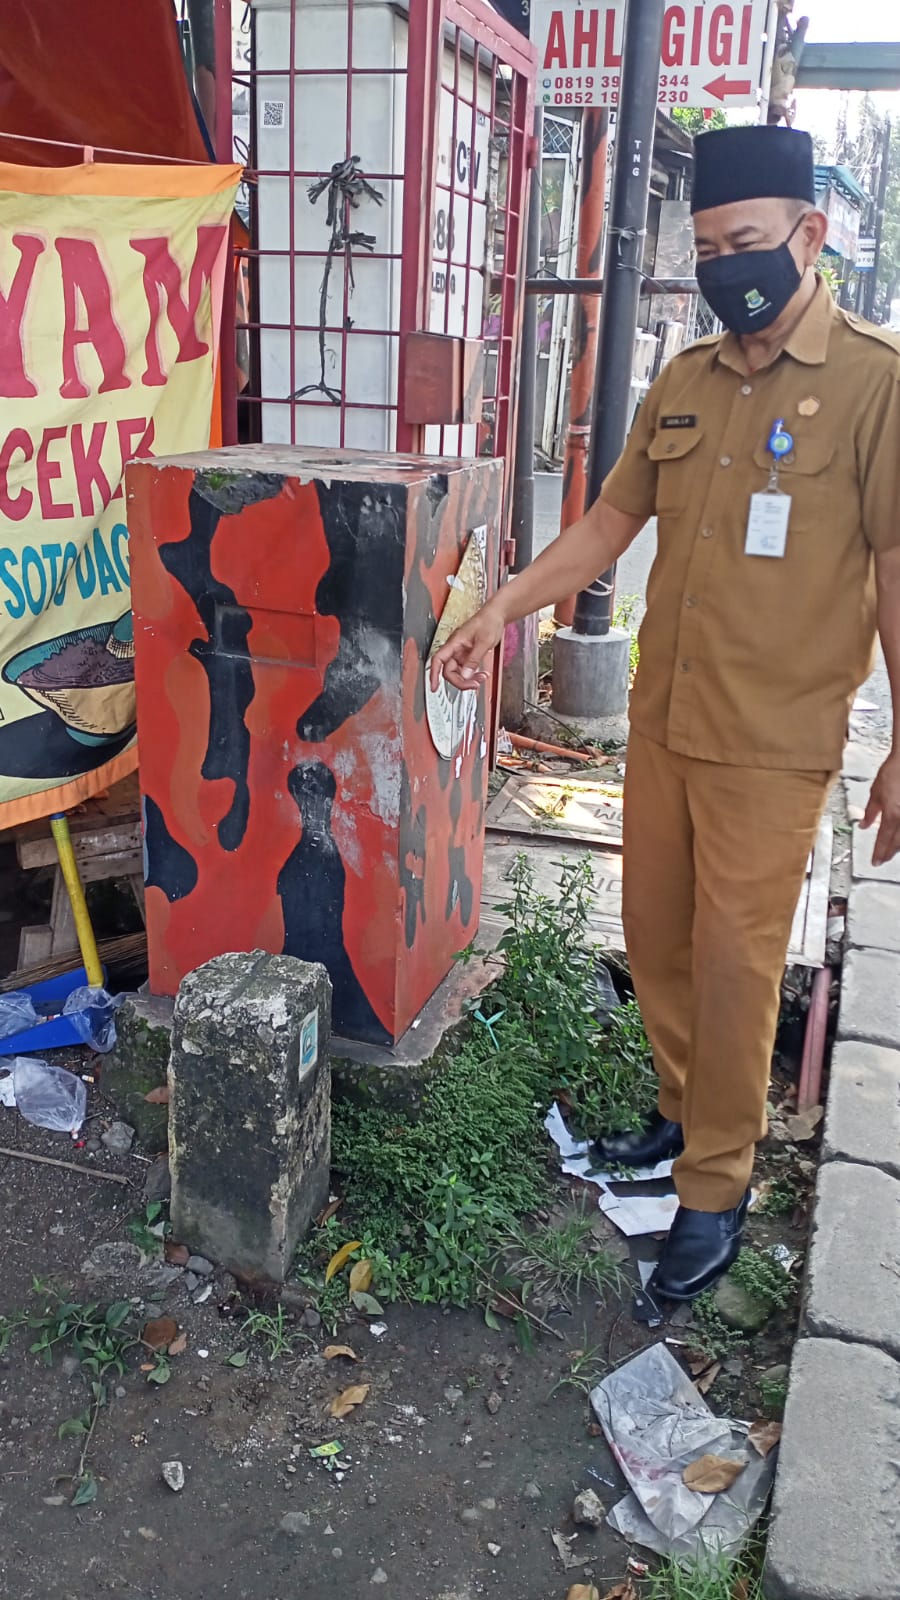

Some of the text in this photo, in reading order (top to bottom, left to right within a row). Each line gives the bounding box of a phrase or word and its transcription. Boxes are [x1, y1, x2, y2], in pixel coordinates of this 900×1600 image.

[660, 4, 752, 67] GIGI
[554, 76, 594, 89] 0819
[554, 91, 593, 104] 0852
[658, 90, 688, 103] 230
[632, 140, 642, 176] TNG
